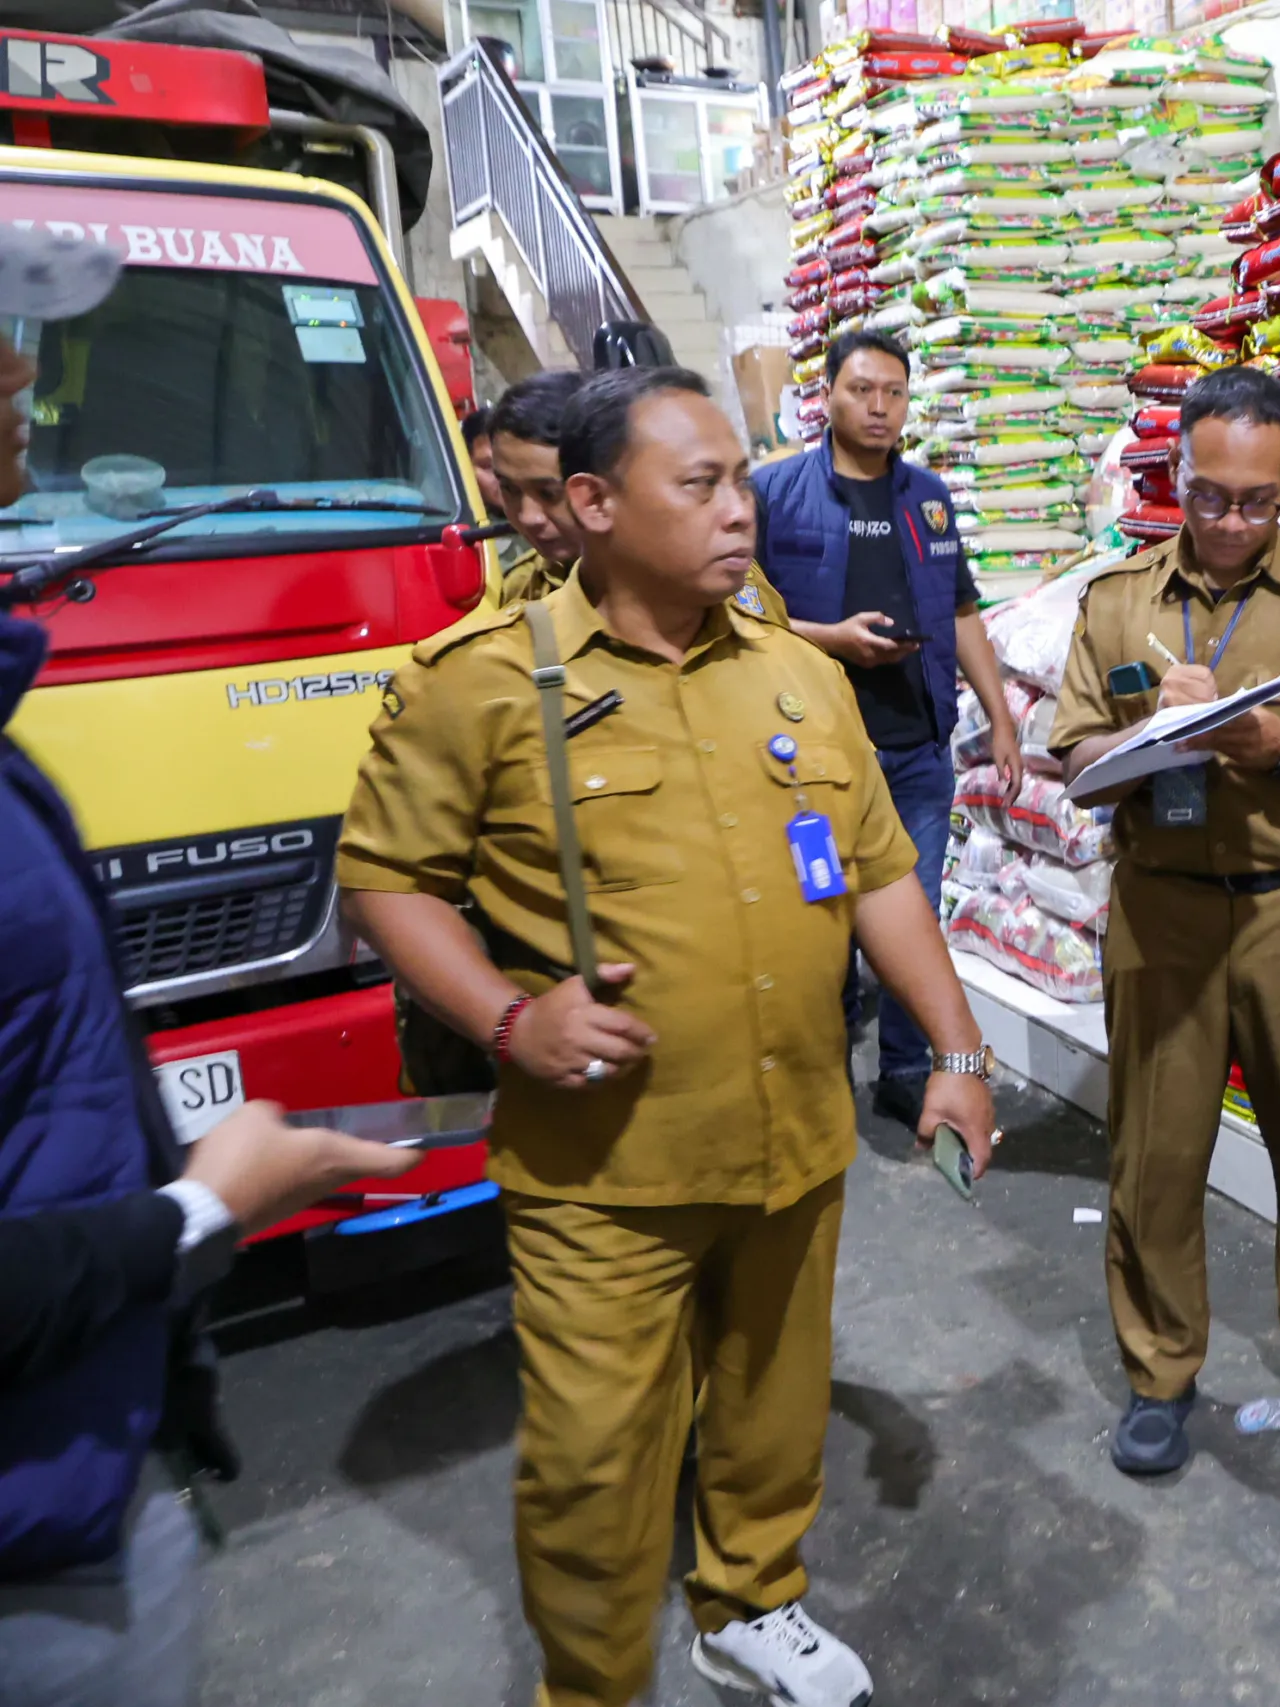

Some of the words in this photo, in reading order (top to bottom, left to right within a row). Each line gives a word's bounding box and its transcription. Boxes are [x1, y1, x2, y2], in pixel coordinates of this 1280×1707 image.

[119, 224, 305, 273] BUANA
[146, 829, 313, 873] FUSO
[179, 1062, 236, 1111] SD
